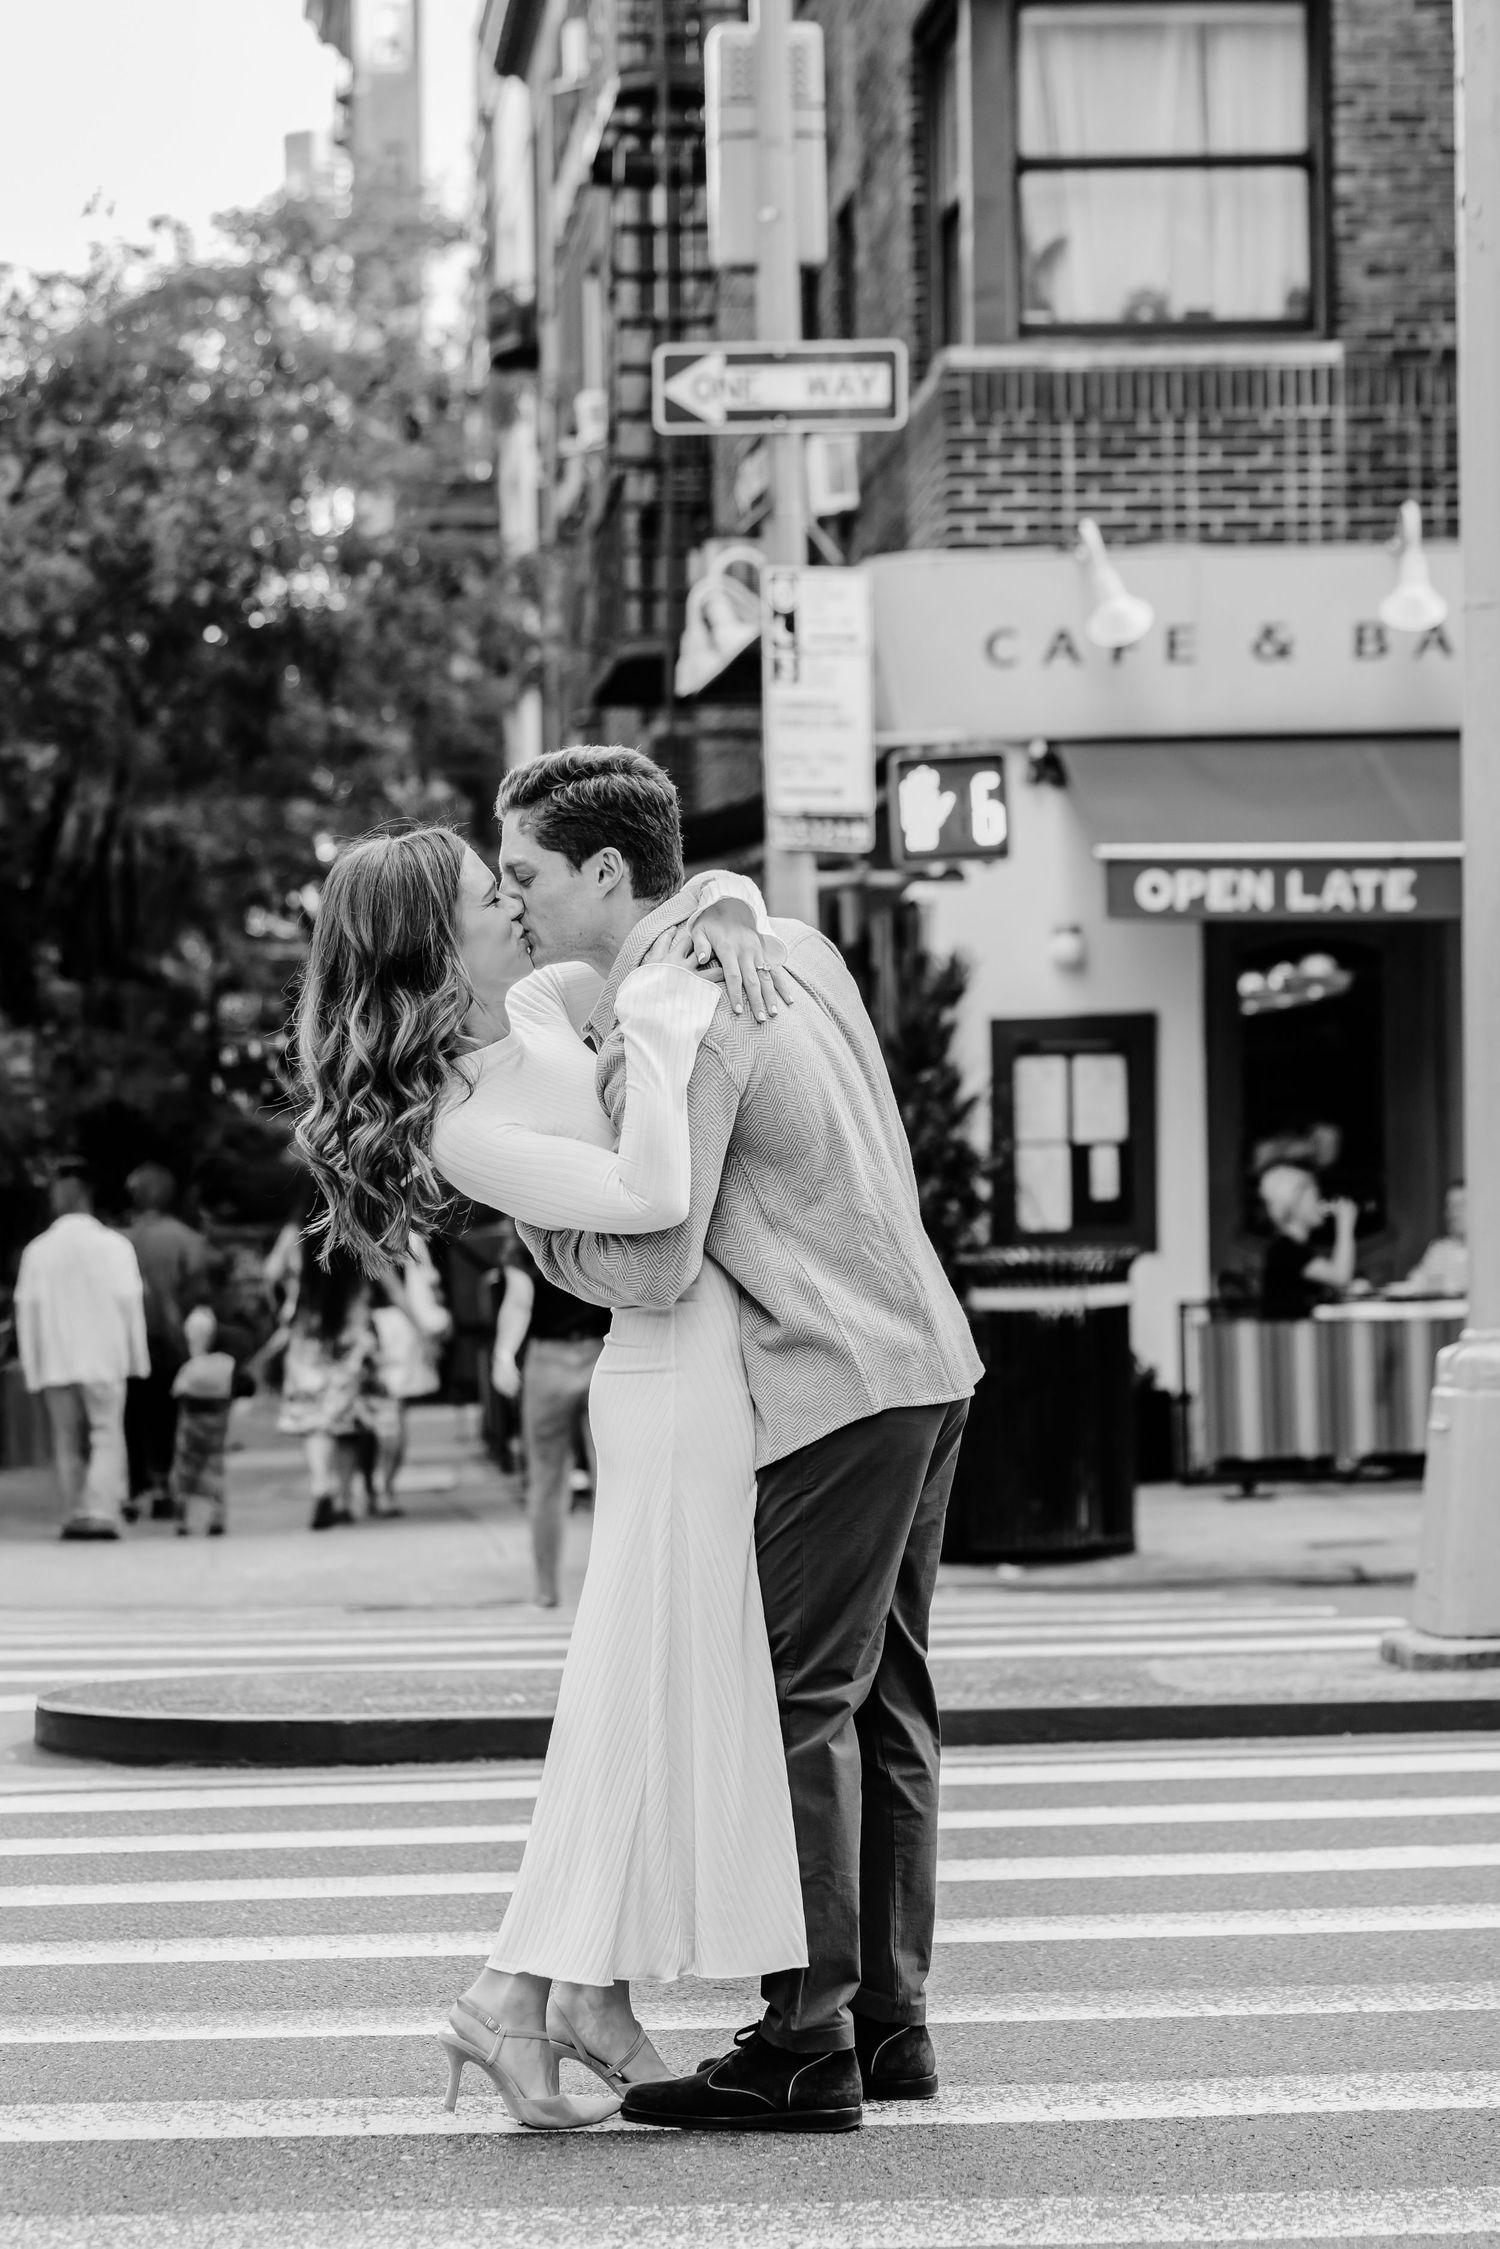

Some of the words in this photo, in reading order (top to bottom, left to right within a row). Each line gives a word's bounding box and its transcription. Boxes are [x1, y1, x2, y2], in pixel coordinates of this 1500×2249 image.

[691, 371, 760, 402] ONE
[807, 374, 879, 398] WAY
[1251, 620, 1293, 664] &
[970, 770, 1008, 847] 6
[1133, 867, 1275, 913] OPEN
[1284, 867, 1418, 913] LATE
